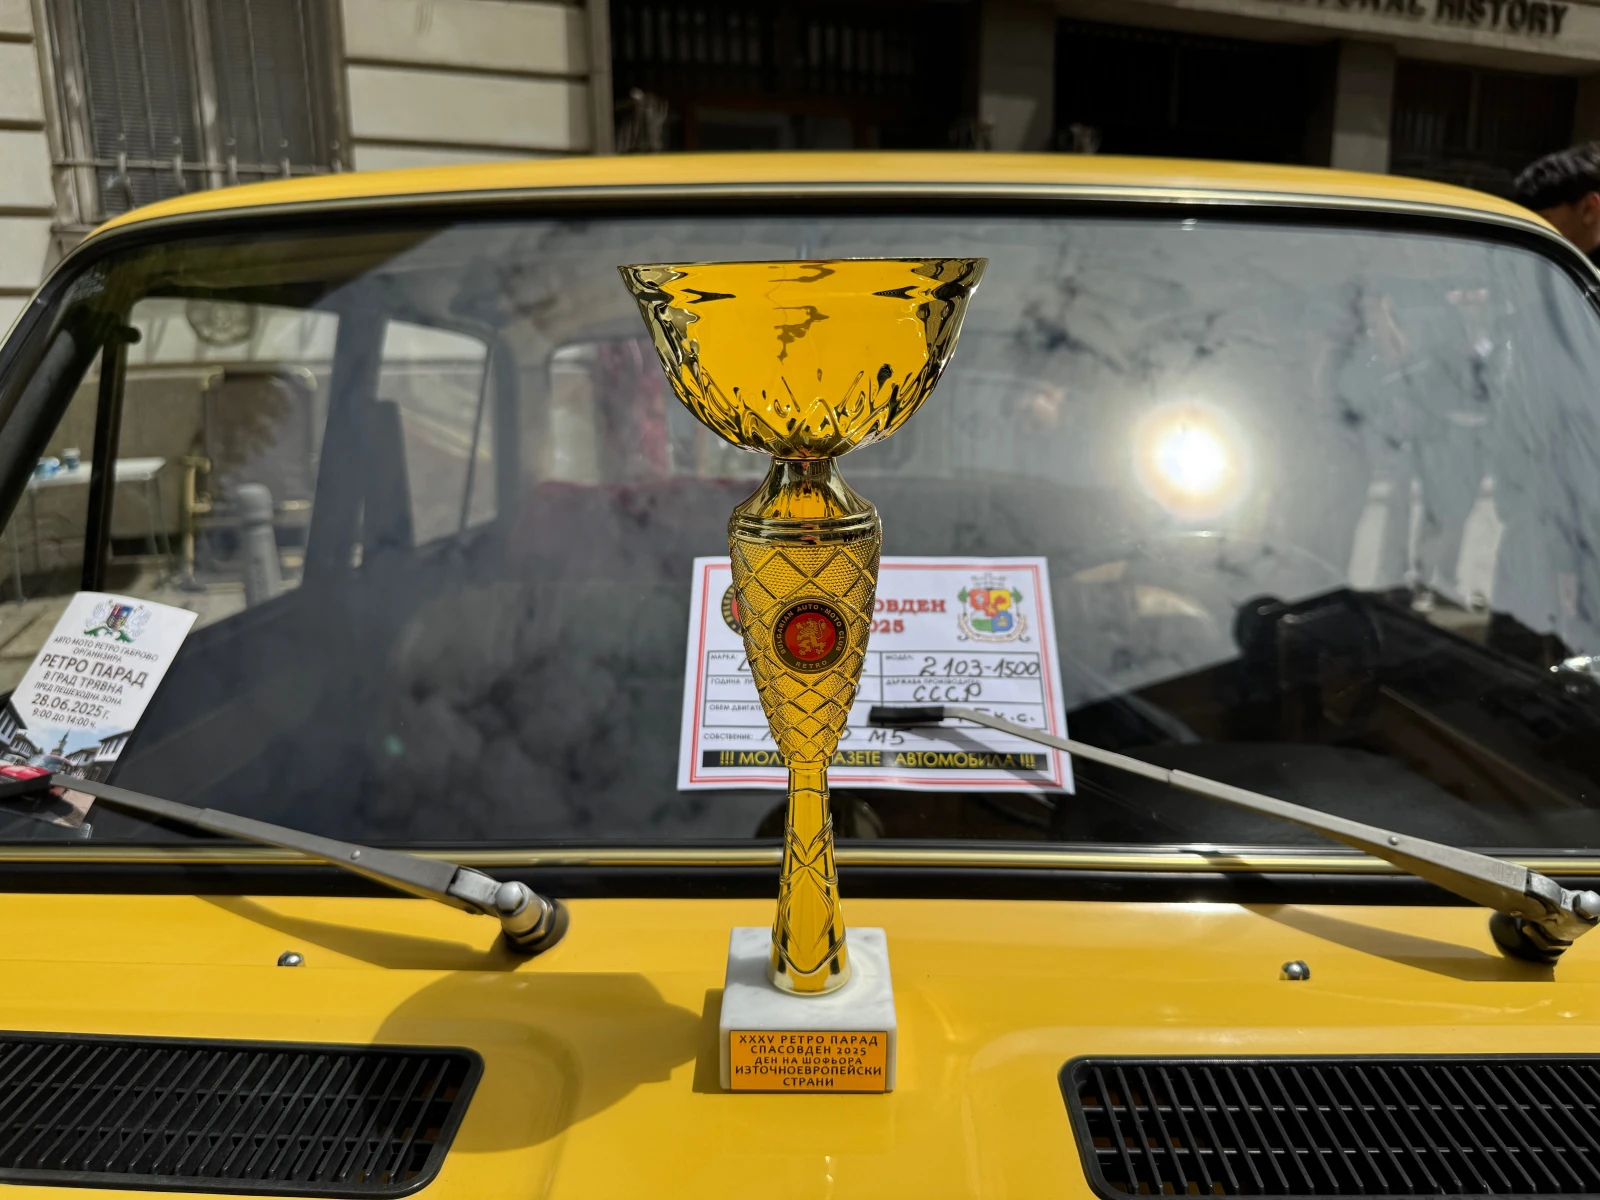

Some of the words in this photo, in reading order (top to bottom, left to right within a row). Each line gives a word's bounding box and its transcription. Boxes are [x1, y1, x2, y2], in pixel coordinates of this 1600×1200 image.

[1435, 0, 1569, 35] HISTORY
[874, 598, 946, 613] ОВДЕН
[776, 611, 794, 655] BULGARIAN
[836, 630, 845, 652] CLUB
[869, 619, 905, 633] 025
[53, 636, 71, 645] АВТО
[72, 638, 94, 648] МОТО
[94, 642, 120, 653] РЕТРО
[121, 647, 159, 662] ГАБРОВО
[73, 647, 122, 663] ОРГАНИЗИРА
[39, 653, 89, 673] РЕТРО
[91, 661, 149, 688] ПАРАД
[795, 660, 827, 669] RETRO
[43, 670, 51, 680] В
[50, 671, 78, 687] ГРАД
[80, 677, 124, 695] ТРЯВНА
[34, 682, 54, 692] ПРЕД
[54, 685, 100, 700] ПЕШЕХОДНА
[100, 696, 122, 706] ЗОНА
[913, 682, 982, 702] СССР
[731, 704, 763, 712] ДВИГАТЕ
[32, 708, 53, 719] 9:00
[66, 715, 90, 728] 14:00
[739, 751, 782, 765] МОЛ
[833, 751, 881, 766] АЗЕТЕ
[894, 752, 1015, 767] АВТОМОБИЛА
[780, 1035, 825, 1044] РЕТРО
[830, 1035, 878, 1047] ПАРАД
[750, 1045, 831, 1057] СПАСОВДЕН
[836, 1046, 867, 1056] 2025
[754, 1056, 778, 1066] ДЕН
[782, 1056, 798, 1064] НА
[802, 1056, 863, 1065] ШОФЬОРА
[735, 1064, 882, 1075] ИЗТОЧНОЕВРОПЕЙСКИ
[783, 1077, 834, 1086] СТРАНИ
